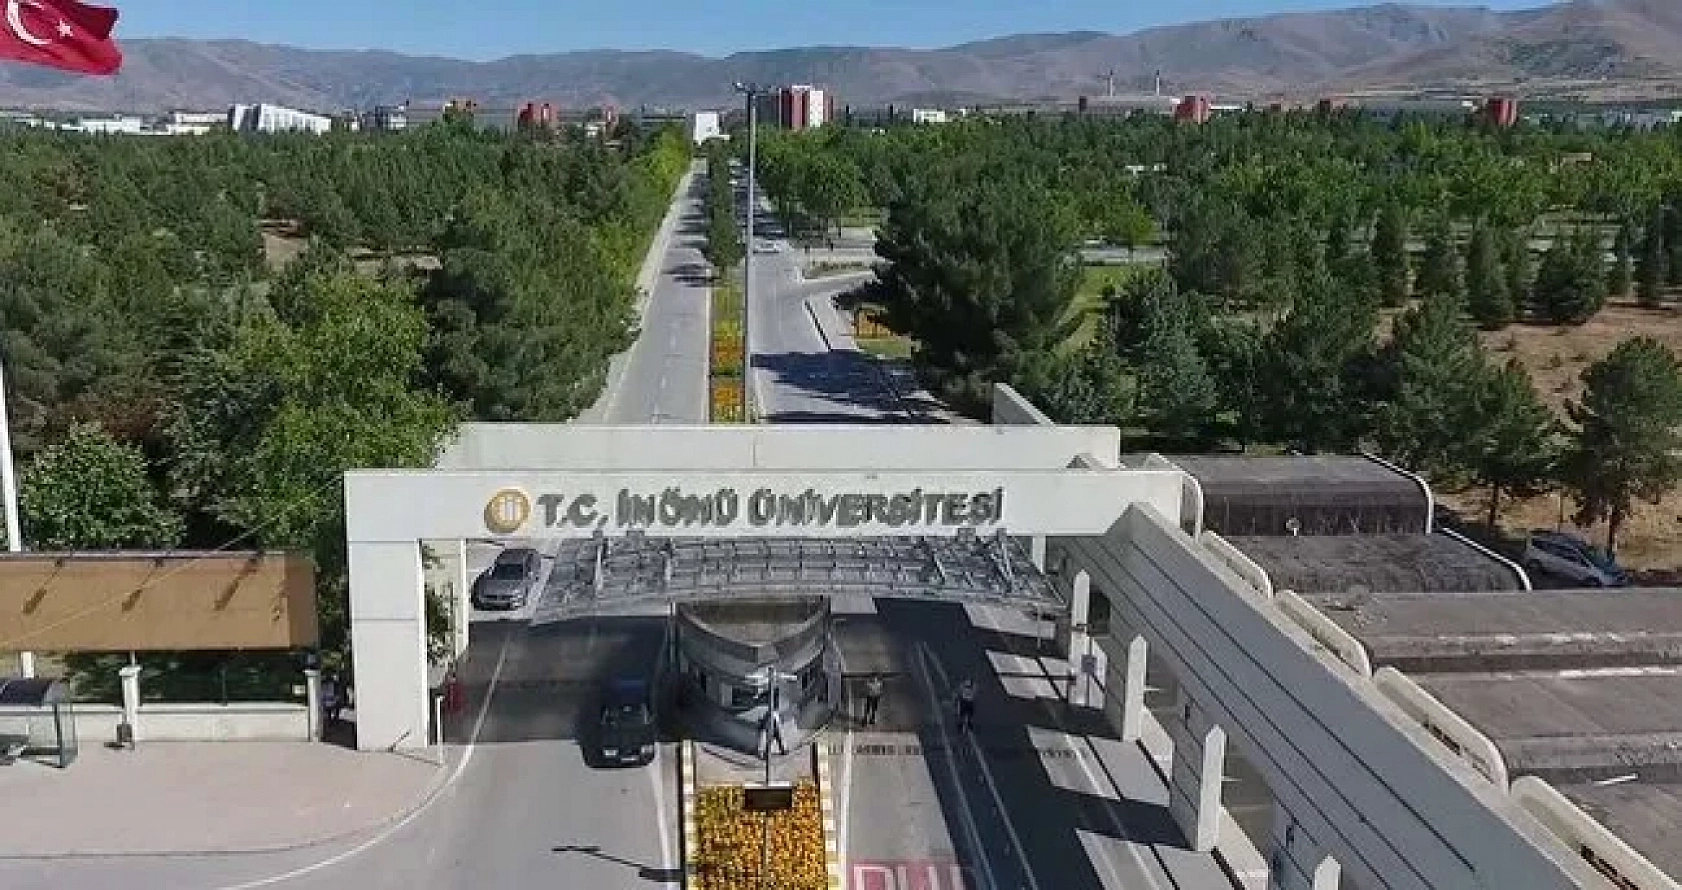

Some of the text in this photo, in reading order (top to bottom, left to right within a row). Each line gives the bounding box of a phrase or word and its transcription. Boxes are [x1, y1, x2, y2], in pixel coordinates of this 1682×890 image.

[537, 486, 1003, 528] T.C. İNÖNÜ ÜNİVERSİTESİ
